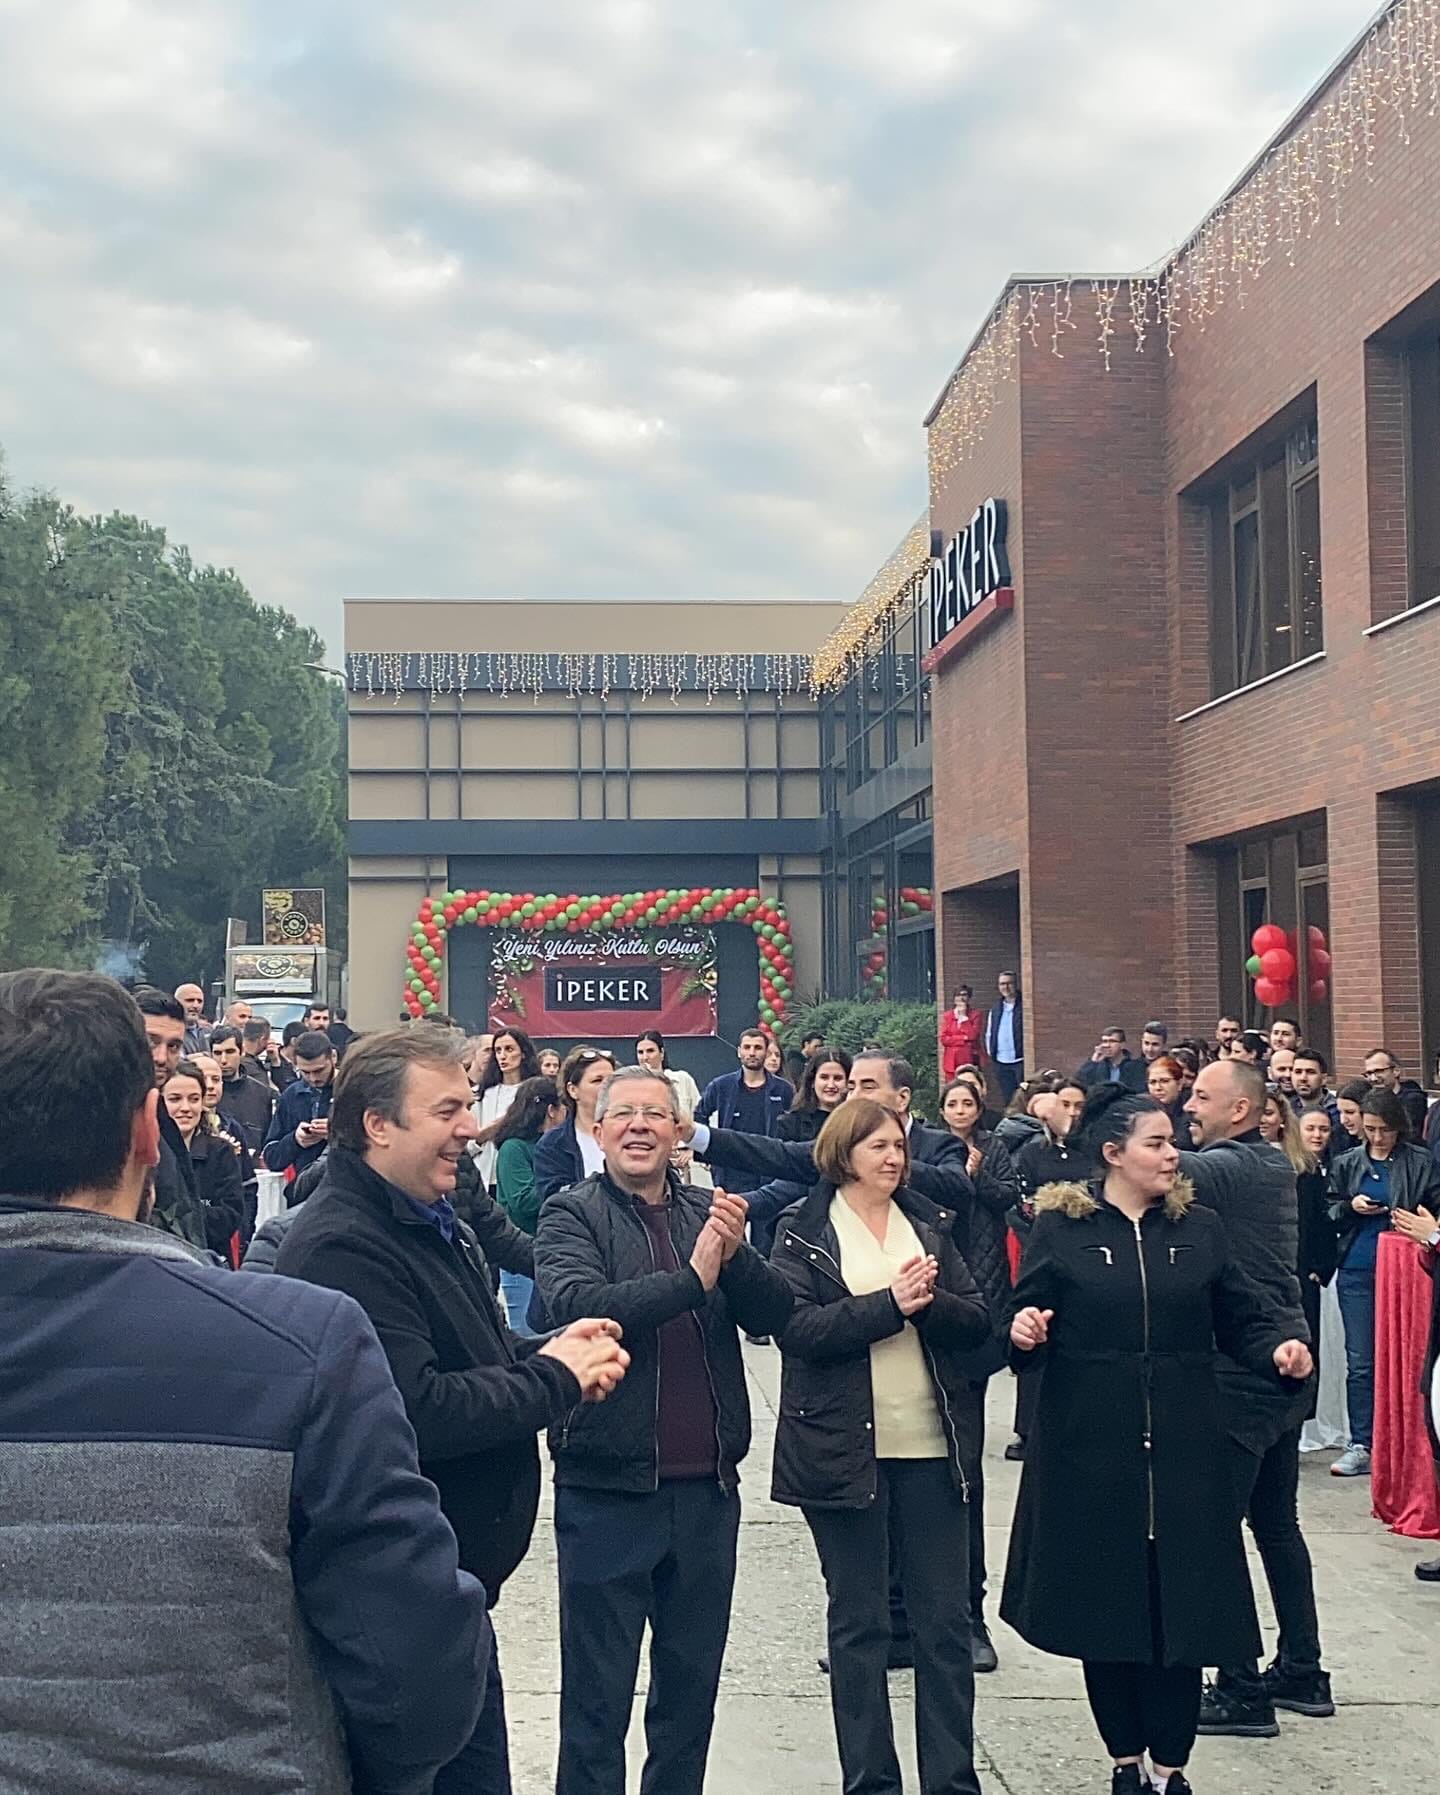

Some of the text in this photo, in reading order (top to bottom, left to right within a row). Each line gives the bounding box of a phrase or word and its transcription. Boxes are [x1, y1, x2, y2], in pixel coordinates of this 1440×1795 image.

[502, 940, 540, 962] Yeni
[602, 938, 650, 959] Kutlu
[654, 938, 702, 956] Olsun
